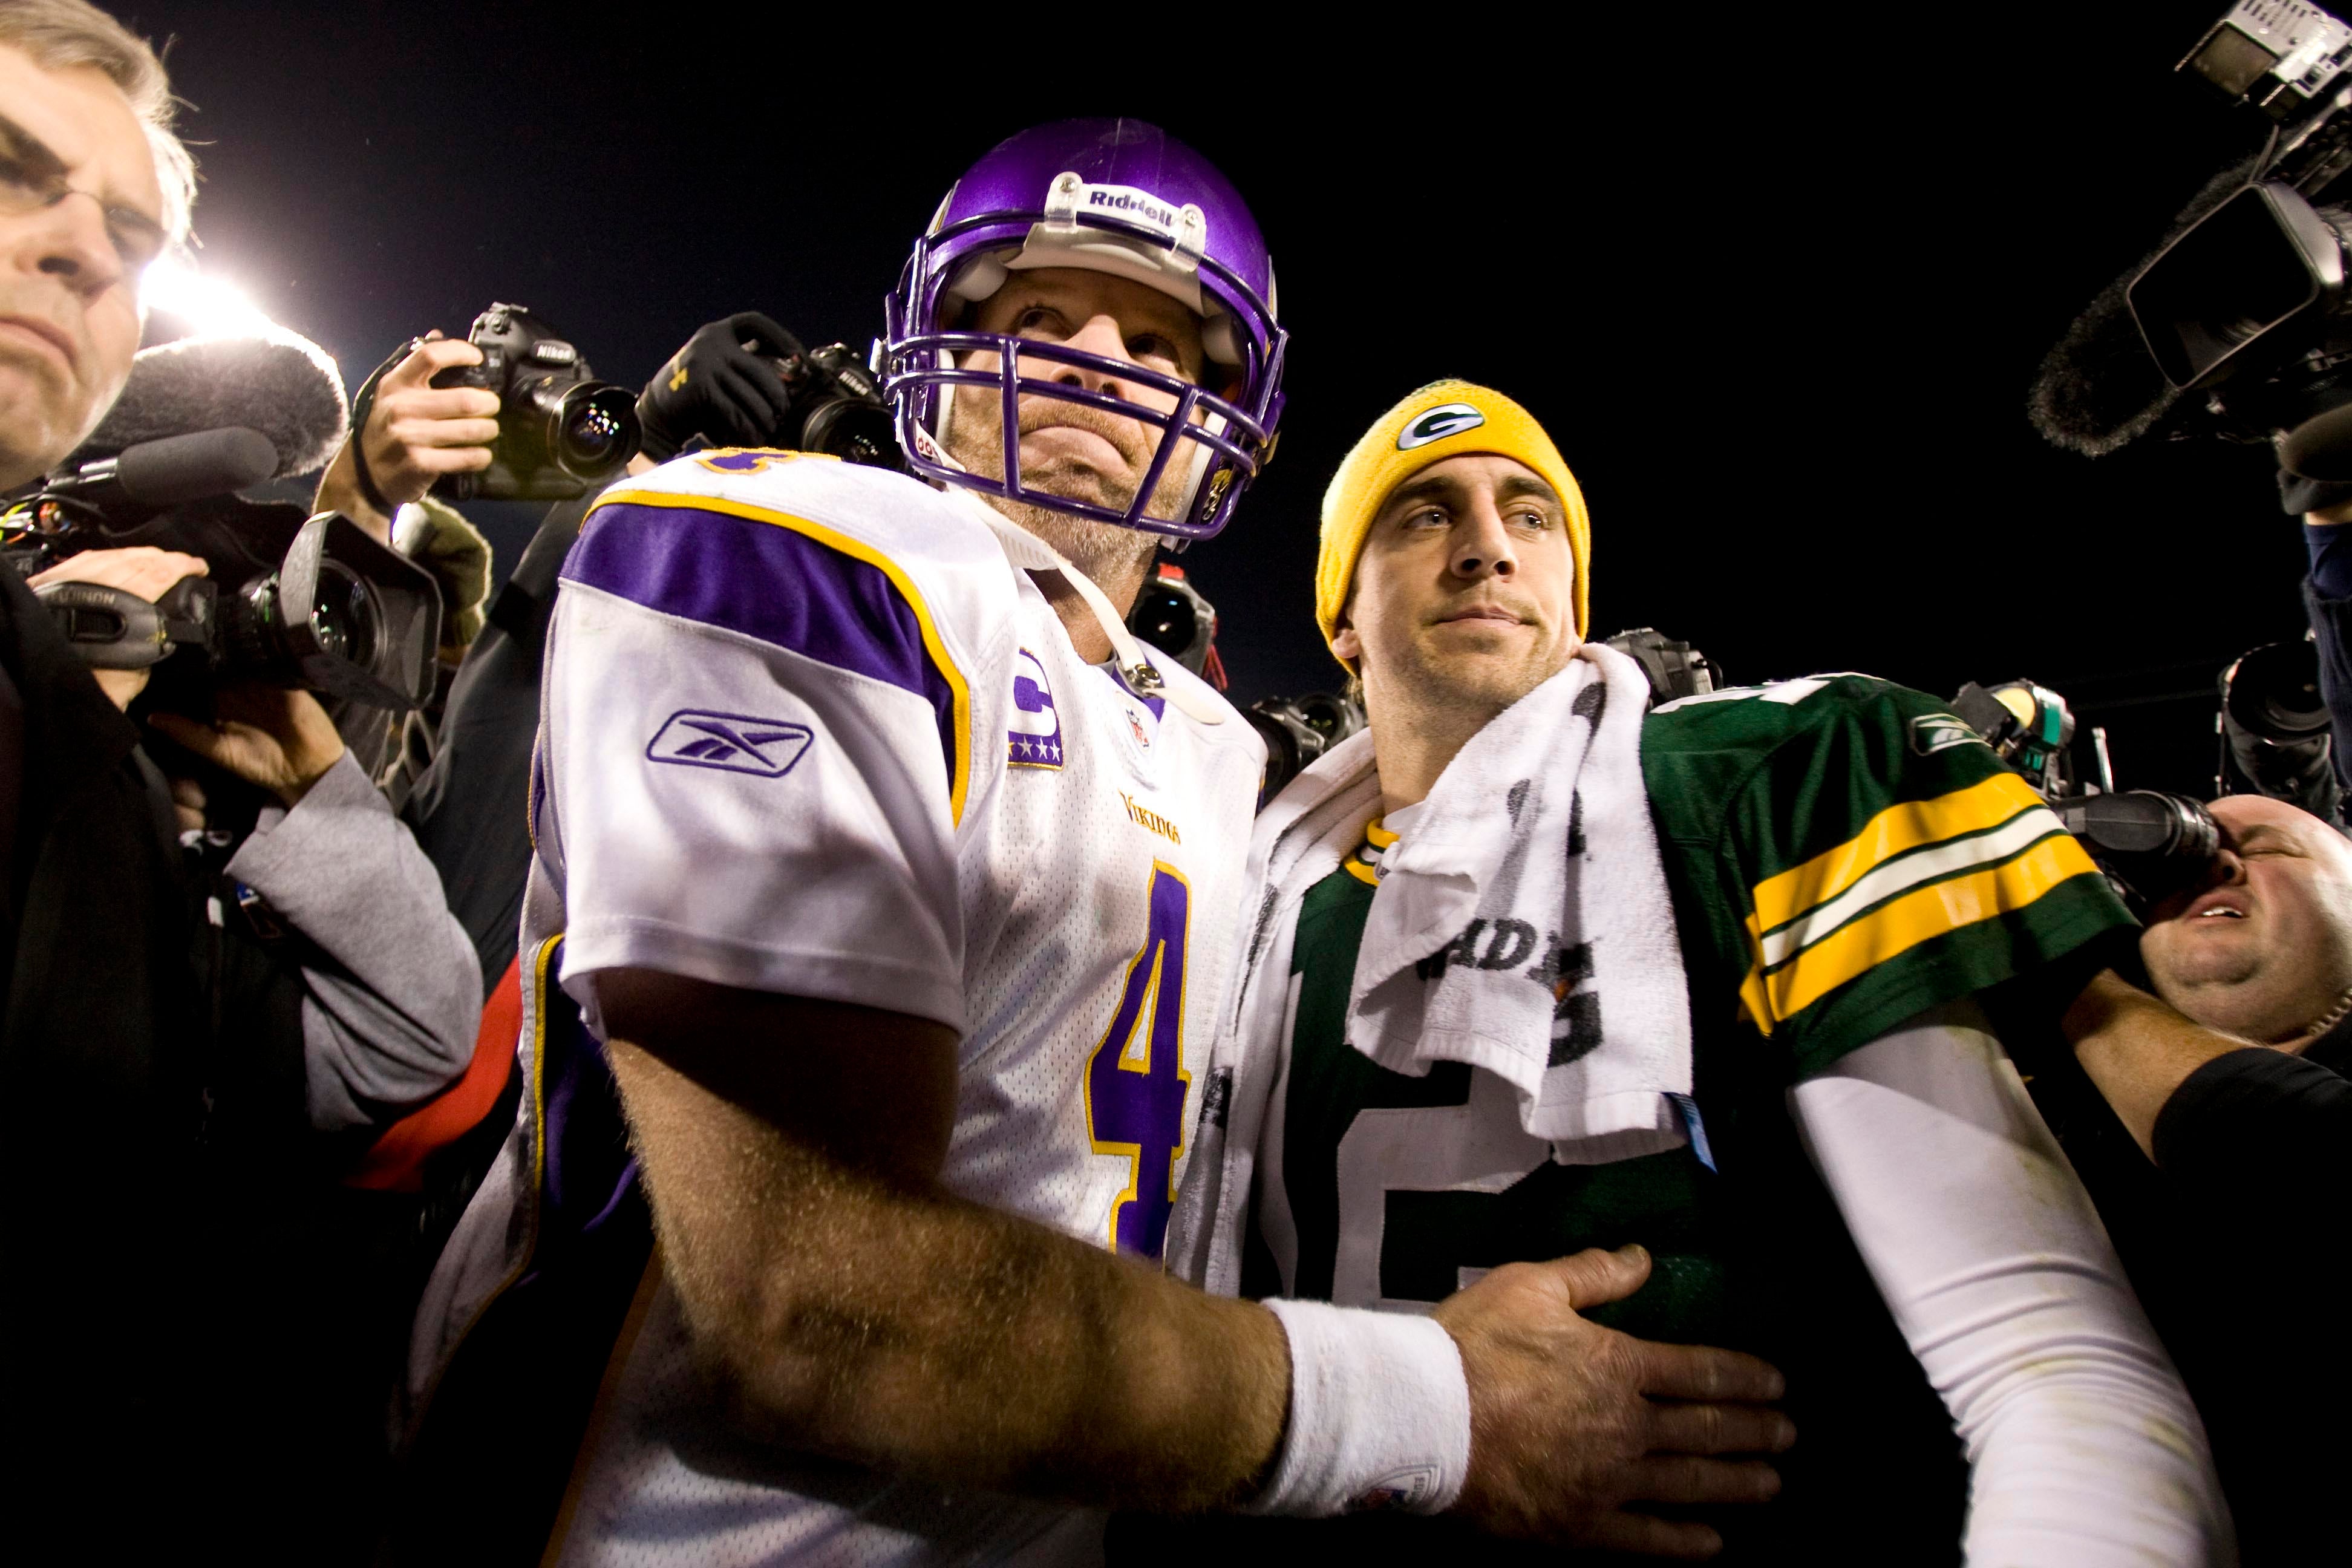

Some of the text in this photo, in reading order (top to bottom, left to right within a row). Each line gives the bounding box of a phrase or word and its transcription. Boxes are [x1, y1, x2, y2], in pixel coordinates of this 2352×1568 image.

[1089, 191, 1172, 227] Riddell
[536, 344, 574, 362] Nikon
[838, 371, 869, 396] Nikon
[1084, 857, 1192, 1259] 4
